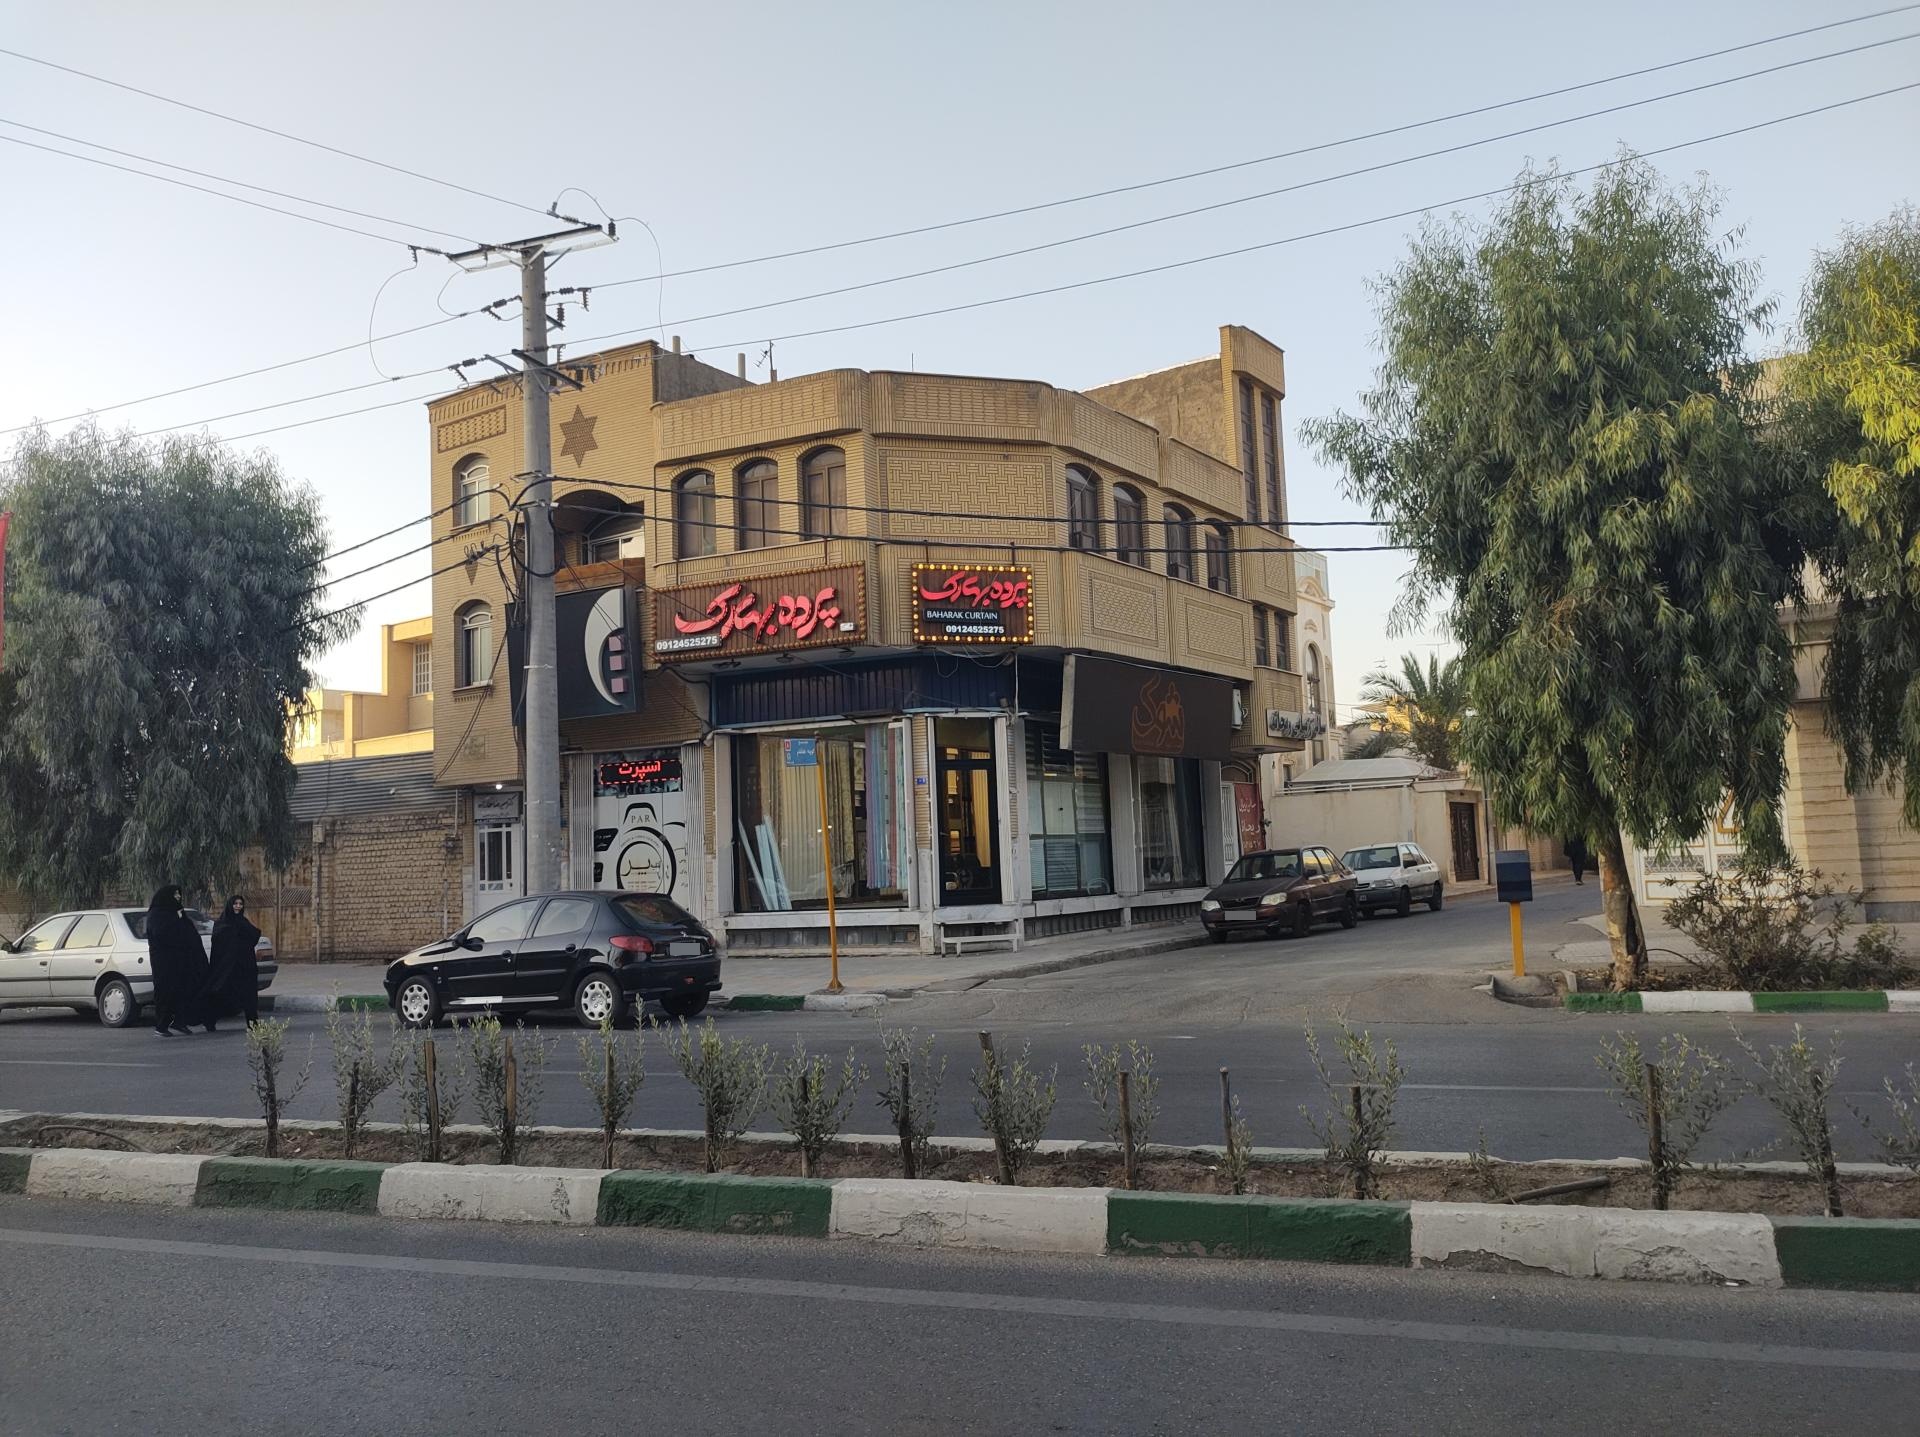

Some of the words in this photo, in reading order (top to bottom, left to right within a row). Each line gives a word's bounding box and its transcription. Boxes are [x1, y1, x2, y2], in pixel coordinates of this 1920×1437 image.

[919, 571, 991, 607] بهارک
[990, 580, 1028, 609] پرده
[674, 583, 780, 643] بهارک
[778, 586, 840, 639] پرده
[926, 610, 963, 619] BAHARAK
[964, 611, 998, 620] CURTAIN
[945, 624, 1005, 634] 09124525275
[656, 635, 718, 650] 09124525275
[619, 760, 661, 779] اسپرت
[631, 814, 651, 823] PAR
